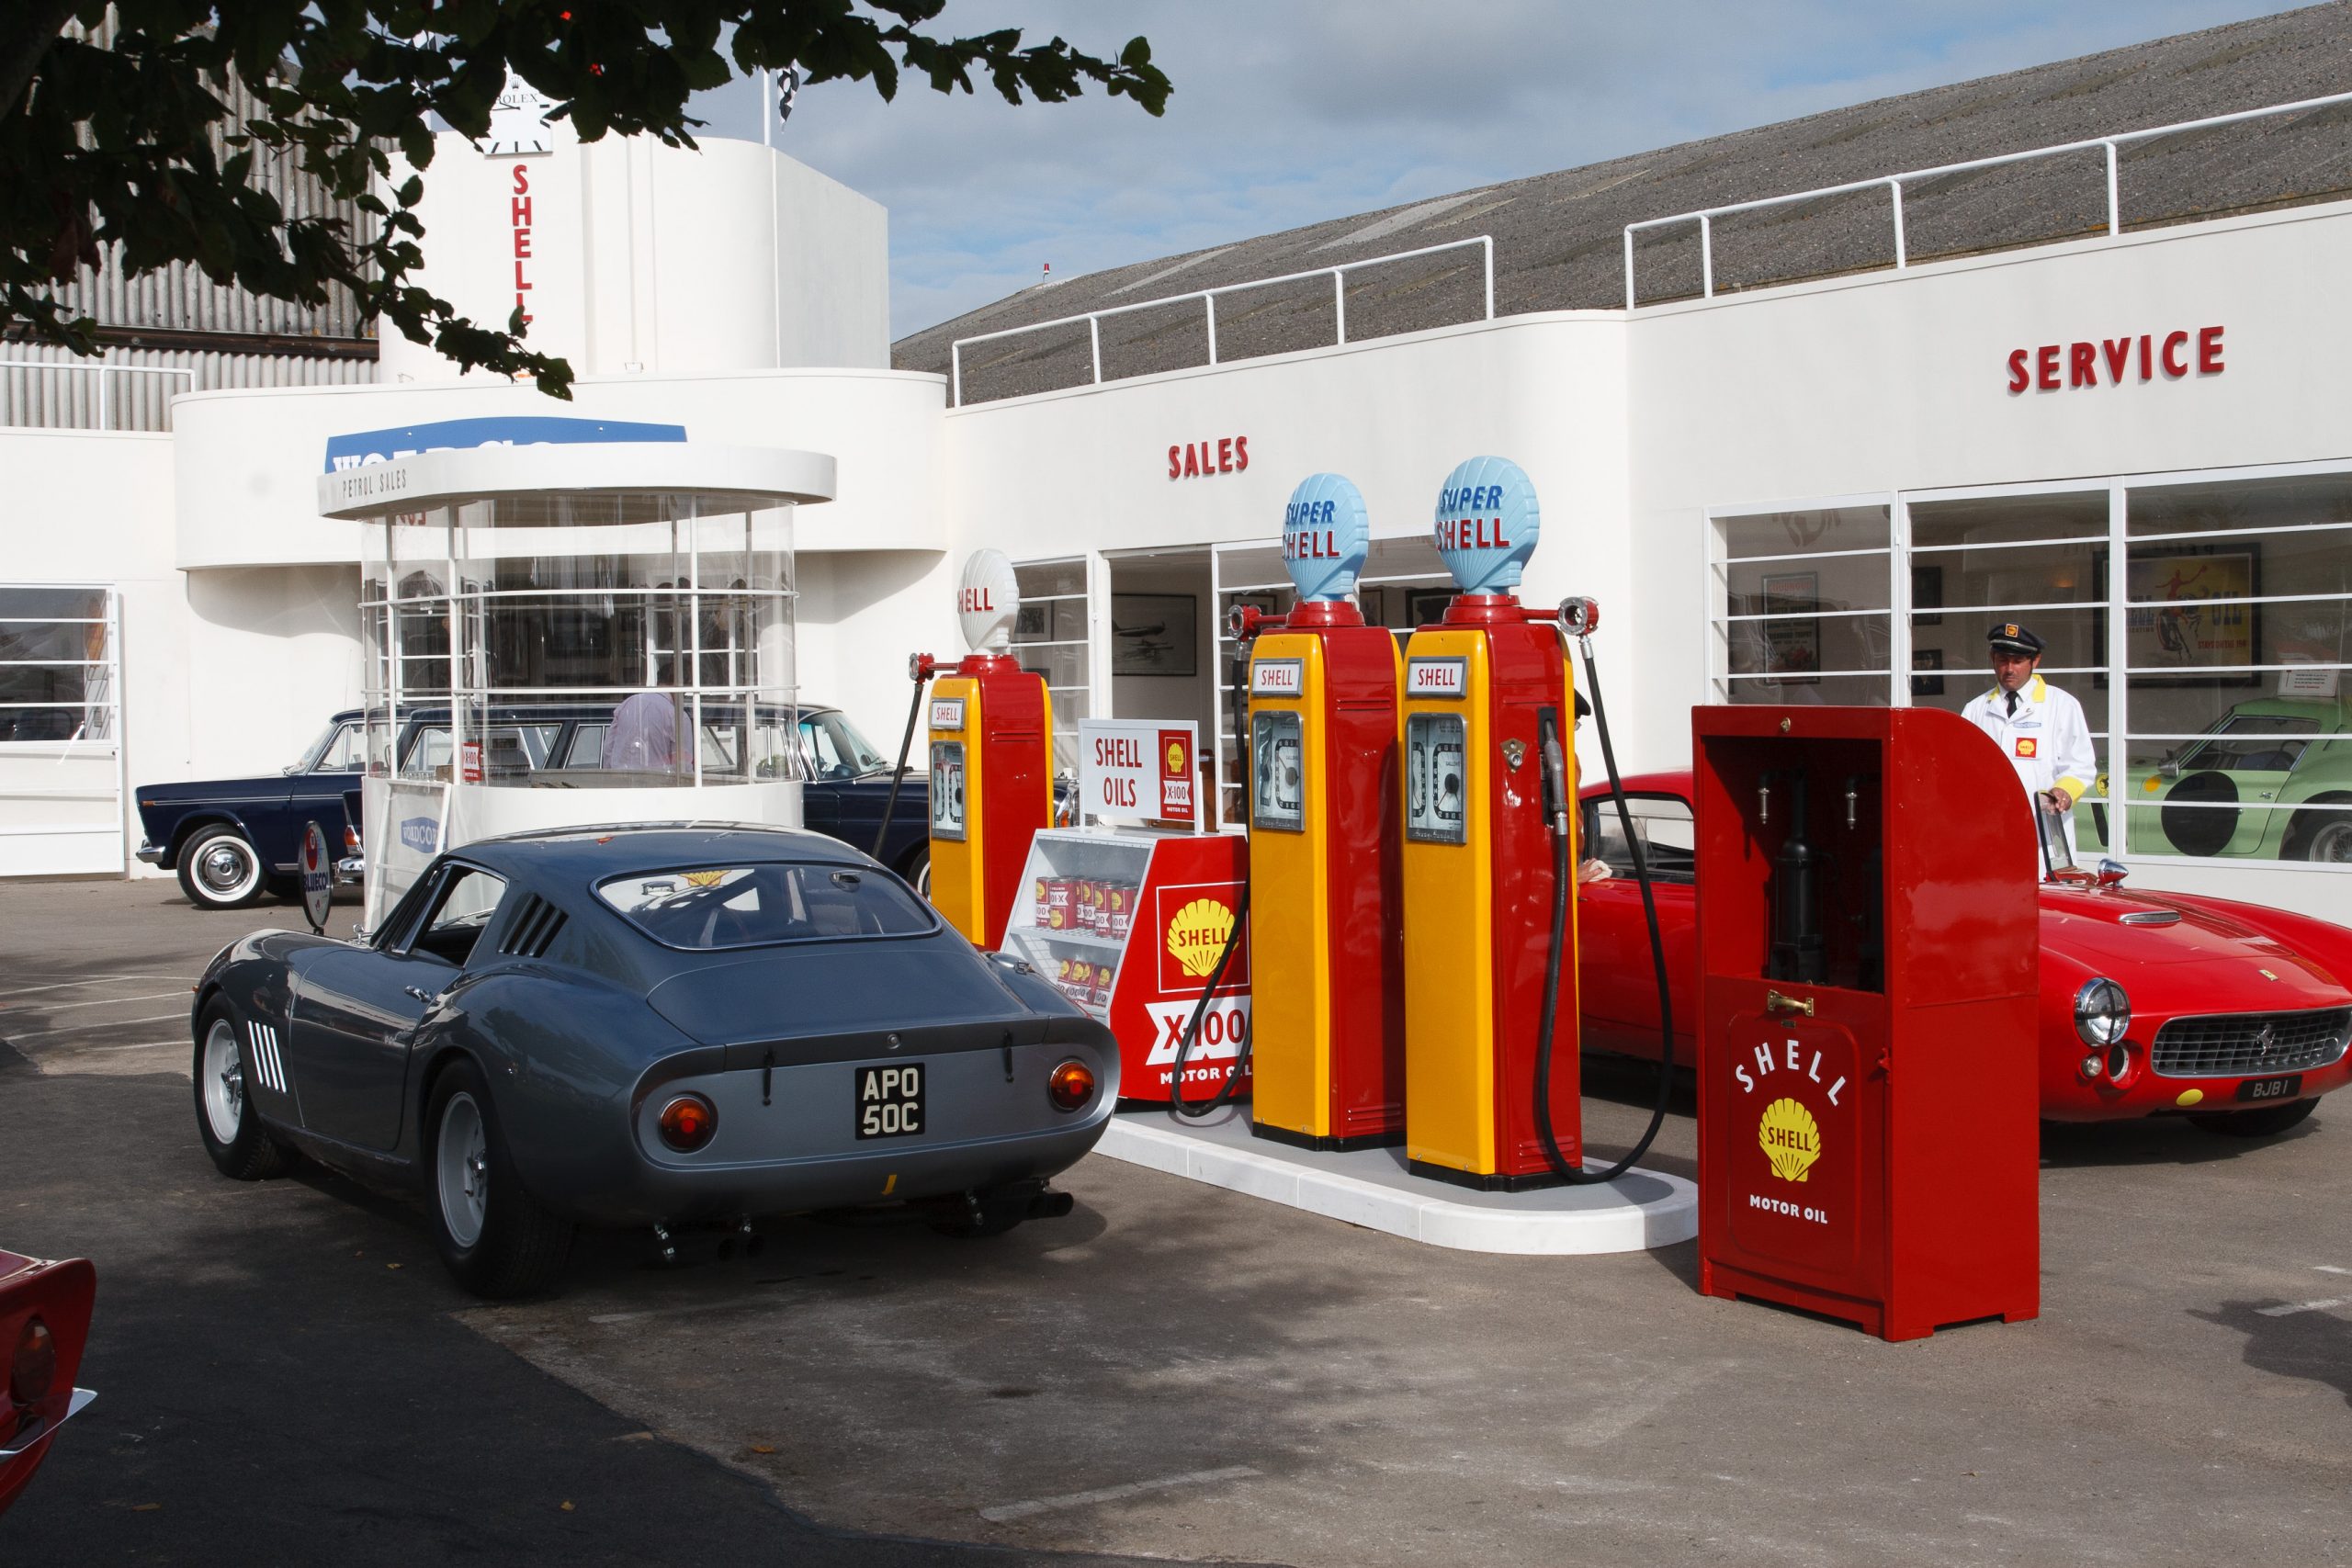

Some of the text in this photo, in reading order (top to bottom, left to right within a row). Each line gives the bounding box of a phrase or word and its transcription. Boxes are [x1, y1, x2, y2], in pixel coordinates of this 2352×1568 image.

[512, 164, 533, 322] SHELL
[2008, 326, 2225, 392] SERVICE
[1169, 435, 1249, 479] SALES
[343, 468, 406, 499] PETROL SALES
[1285, 501, 1335, 525] SUPER
[1440, 485, 1503, 513] SUPER
[1281, 530, 1340, 559] SHELL
[1435, 517, 1510, 551] SHELL
[957, 588, 994, 614] HELL
[1261, 670, 1293, 686] SHELL
[1418, 668, 1455, 686] SHELL
[936, 706, 957, 721] SHELL
[1095, 738, 1142, 768] SHELL
[1104, 777, 1136, 807] OILS
[1179, 928, 1227, 947] SHELL
[863, 1067, 919, 1100] APO
[1226, 1065, 1253, 1077] OL
[1736, 1039, 1847, 1107] SHELL
[2253, 1082, 2281, 1098] BJB
[863, 1102, 919, 1134] 50C
[1768, 1126, 1812, 1152] SHELL
[1749, 1194, 1828, 1224] MOTOR OIL
